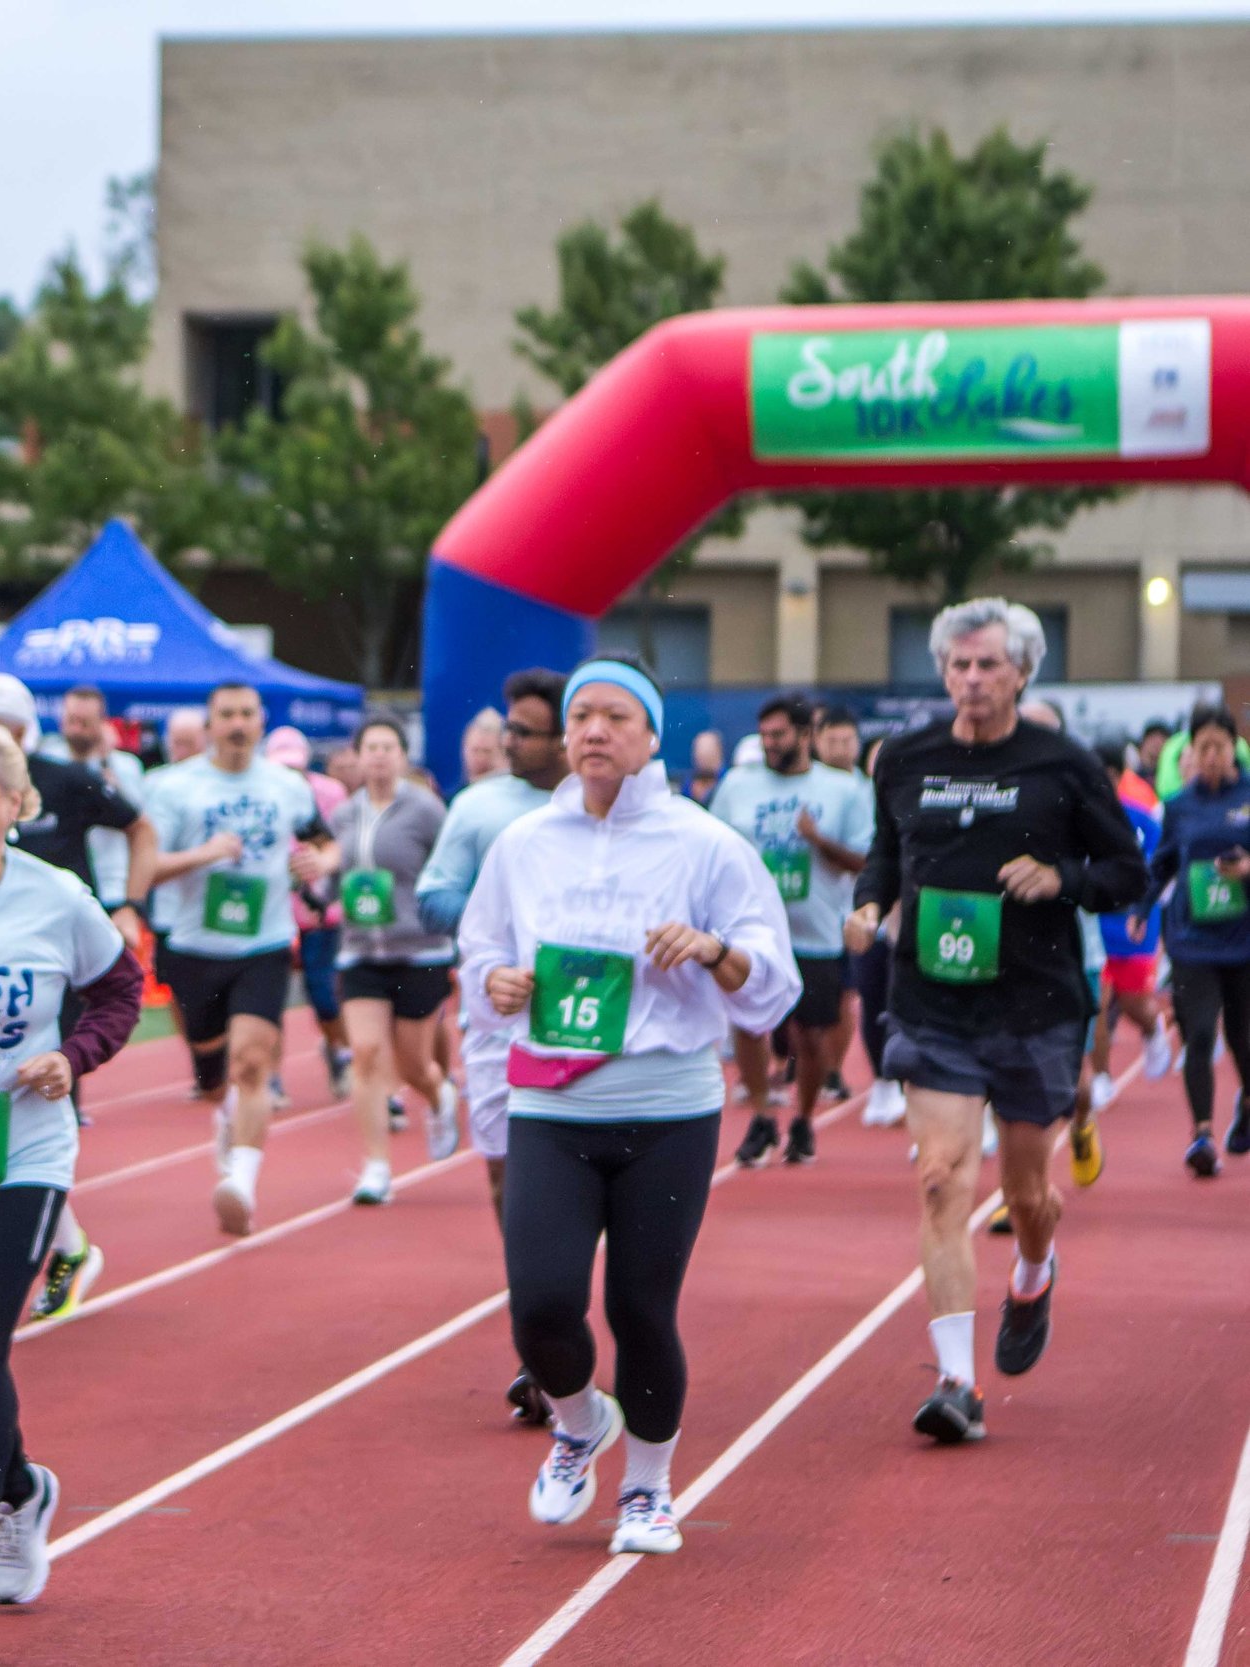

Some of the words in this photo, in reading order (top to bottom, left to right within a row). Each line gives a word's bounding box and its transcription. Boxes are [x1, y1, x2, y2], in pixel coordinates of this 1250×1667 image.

[787, 330, 949, 408] South
[856, 401, 926, 439] 10K
[939, 932, 974, 965] 99
[558, 995, 600, 1030] 15
